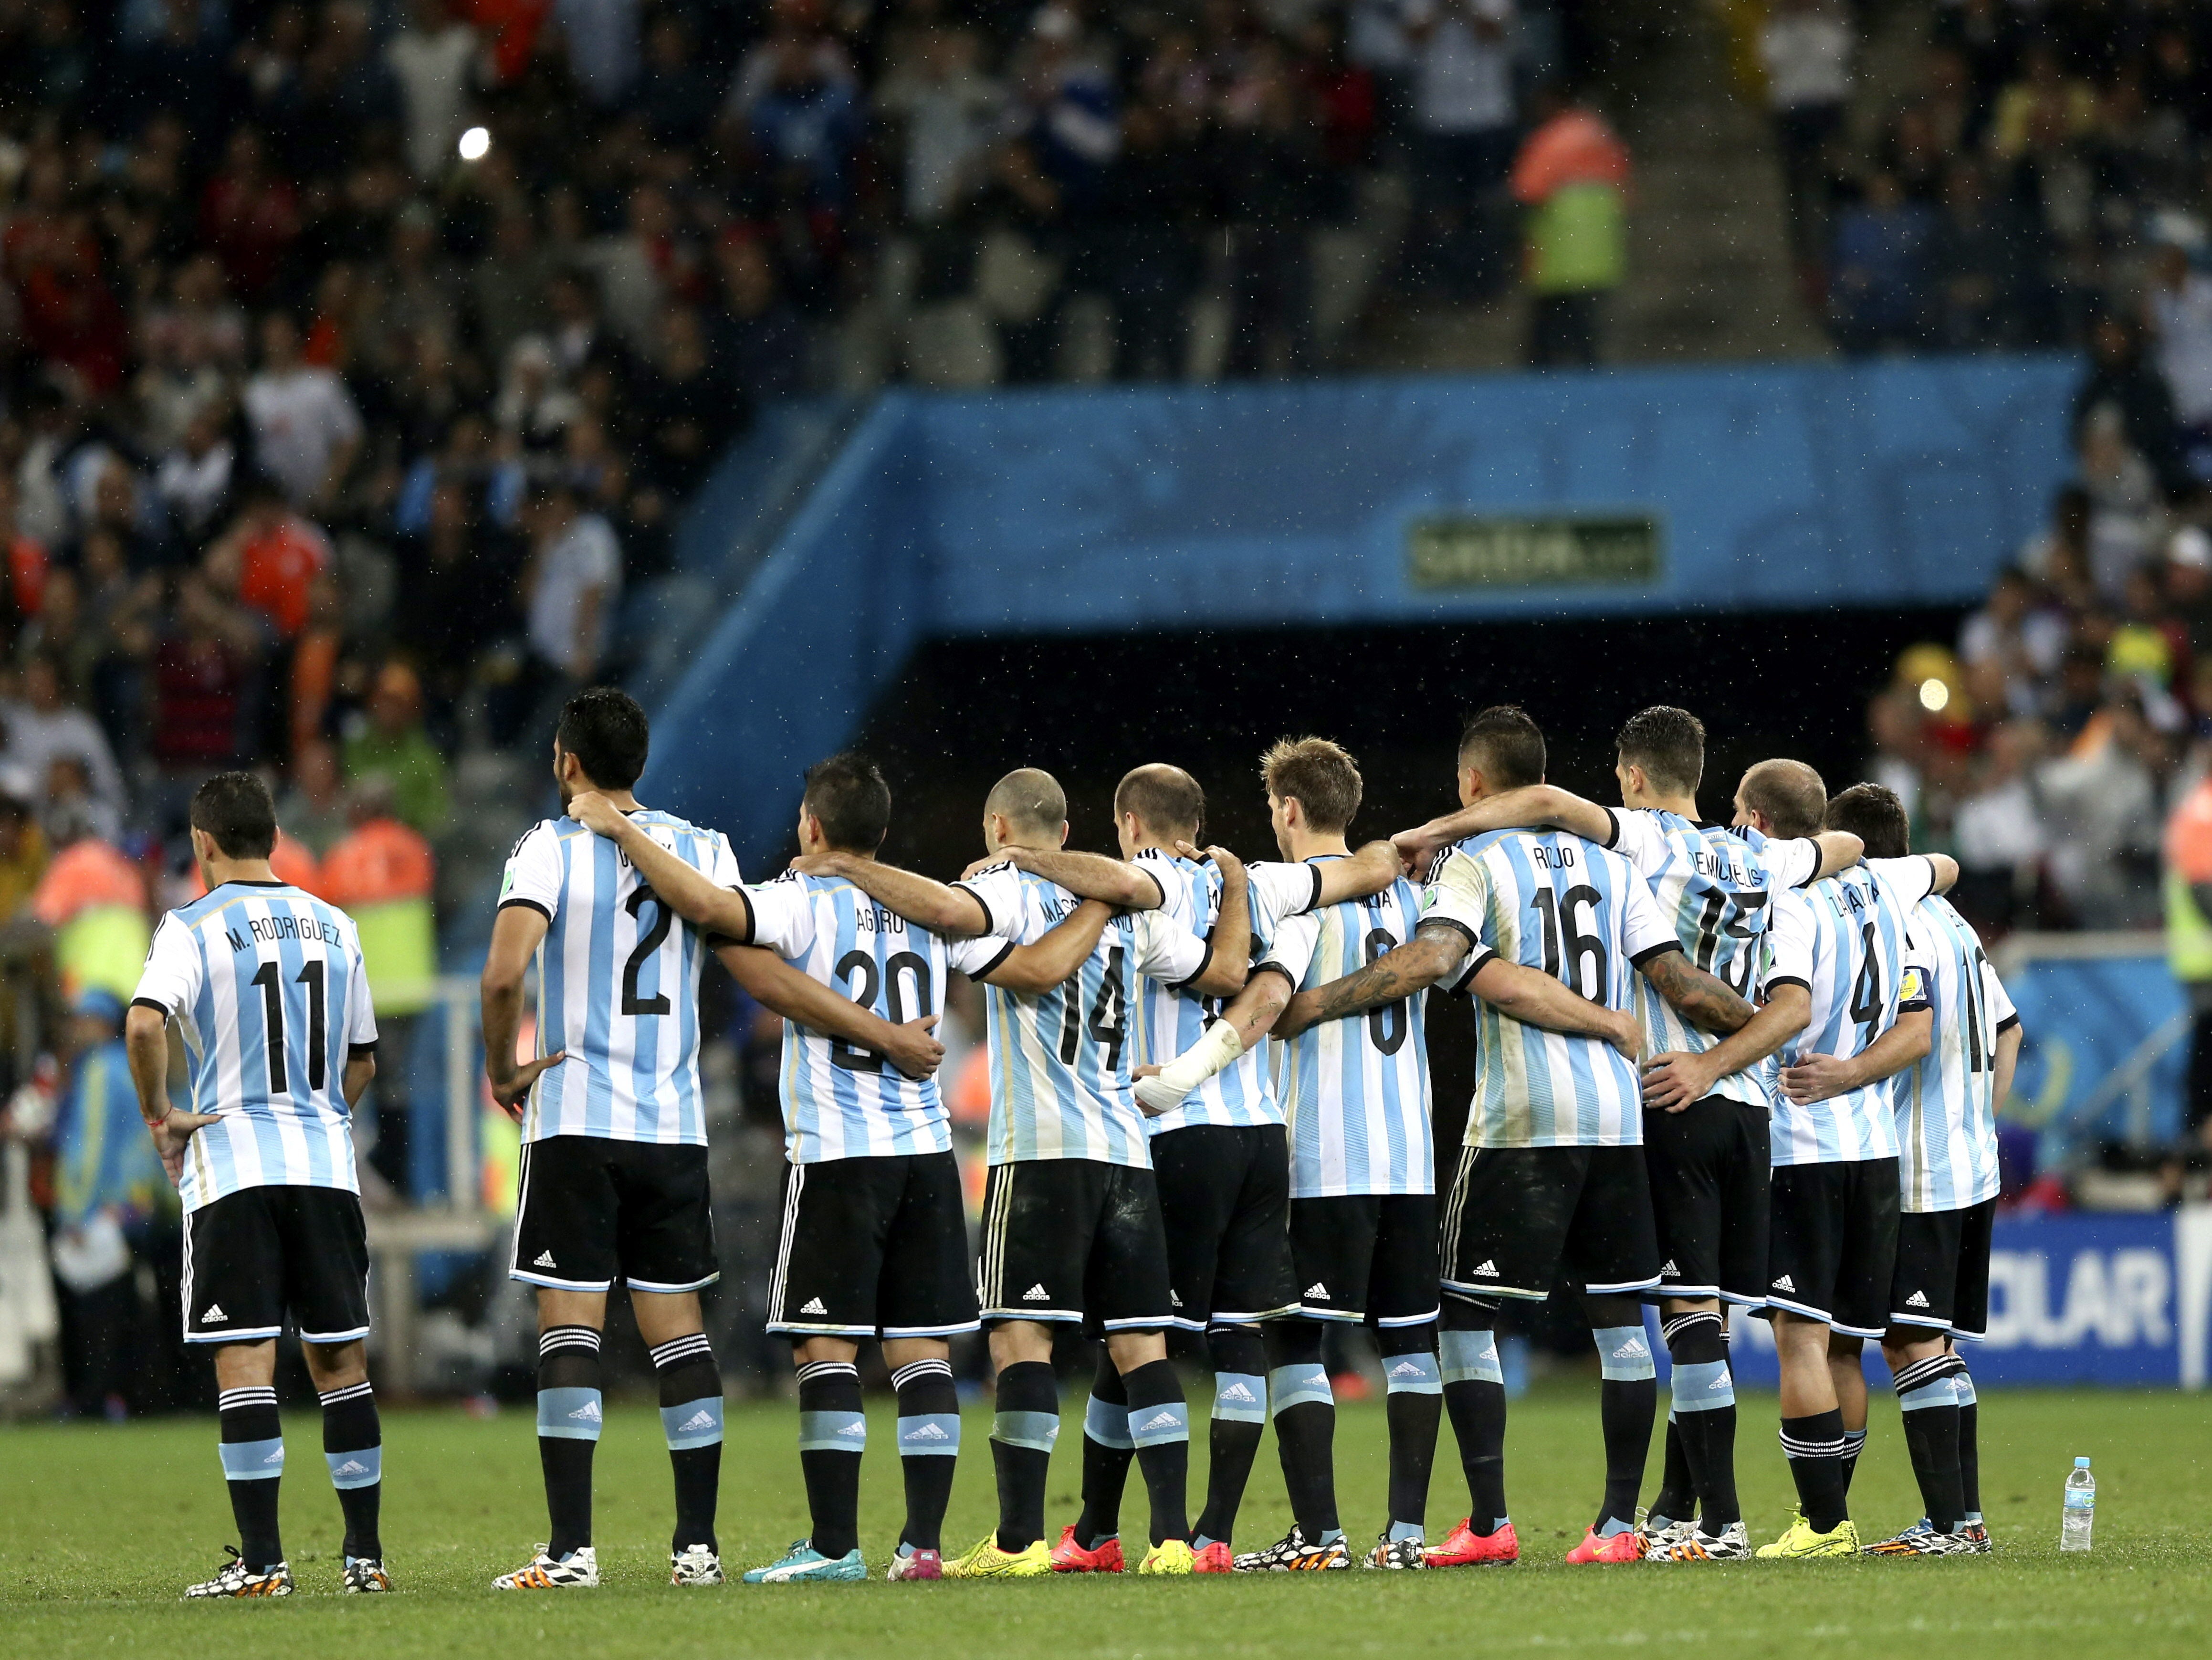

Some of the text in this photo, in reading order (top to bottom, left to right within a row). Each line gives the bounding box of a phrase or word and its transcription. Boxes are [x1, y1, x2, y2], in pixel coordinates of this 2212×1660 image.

[1533, 847, 1574, 870] ROJO
[226, 915, 342, 953] M. RODRÍGUEZ
[622, 885, 672, 1015] 2
[1531, 884, 1607, 1007] 16
[1697, 885, 1768, 998] 15
[831, 950, 930, 1073] 20
[1060, 946, 1125, 1071] 14
[1850, 921, 1883, 1046] 4
[251, 960, 325, 1094] 11
[534, 1259, 556, 1269] adidas
[1304, 1292, 1331, 1300] adidas
[1772, 1282, 1795, 1293] adidas
[1973, 1247, 2174, 1351] OLAR
[201, 1314, 228, 1323] adidas
[1906, 1299, 1929, 1308] adidas
[1220, 1393, 1256, 1403] adidas
